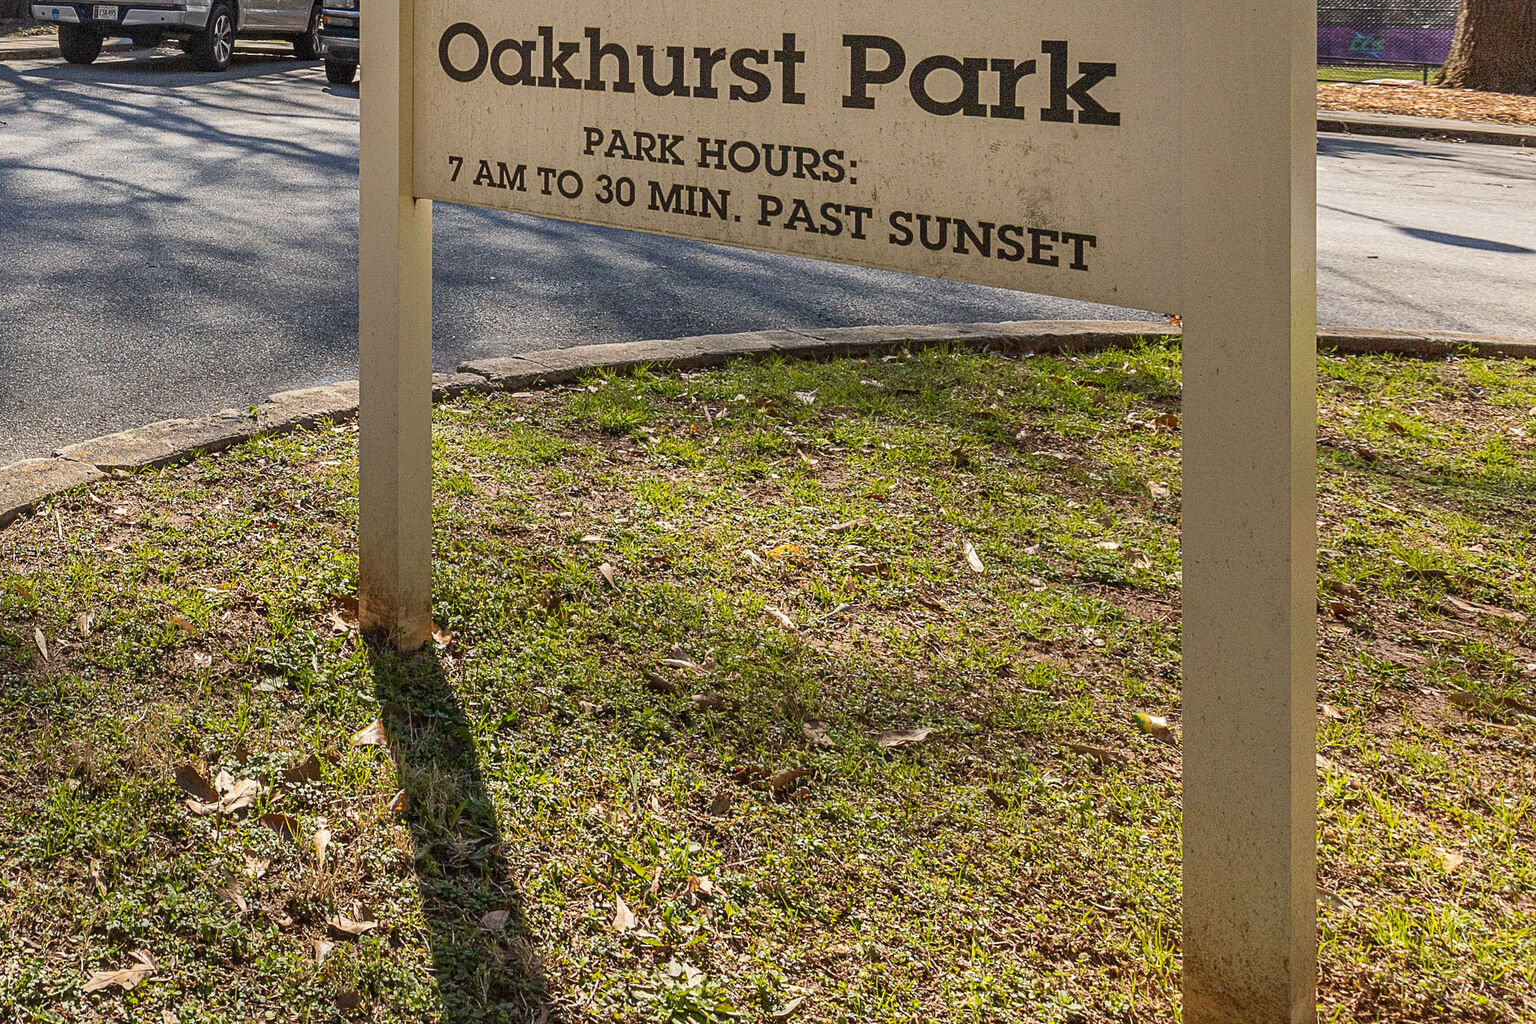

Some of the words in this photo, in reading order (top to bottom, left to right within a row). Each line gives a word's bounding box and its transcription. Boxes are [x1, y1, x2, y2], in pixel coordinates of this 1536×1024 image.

[438, 22, 806, 105] Oakhurst
[841, 34, 1121, 127] Park
[583, 126, 685, 166] PARK
[697, 136, 859, 185] HOURS:
[448, 155, 464, 182] 7
[472, 159, 527, 192] AM
[537, 166, 584, 200] TO
[594, 174, 636, 207] 30
[647, 180, 742, 224] MIN.
[757, 193, 873, 241] PAST
[888, 209, 1097, 273] SUNSET
